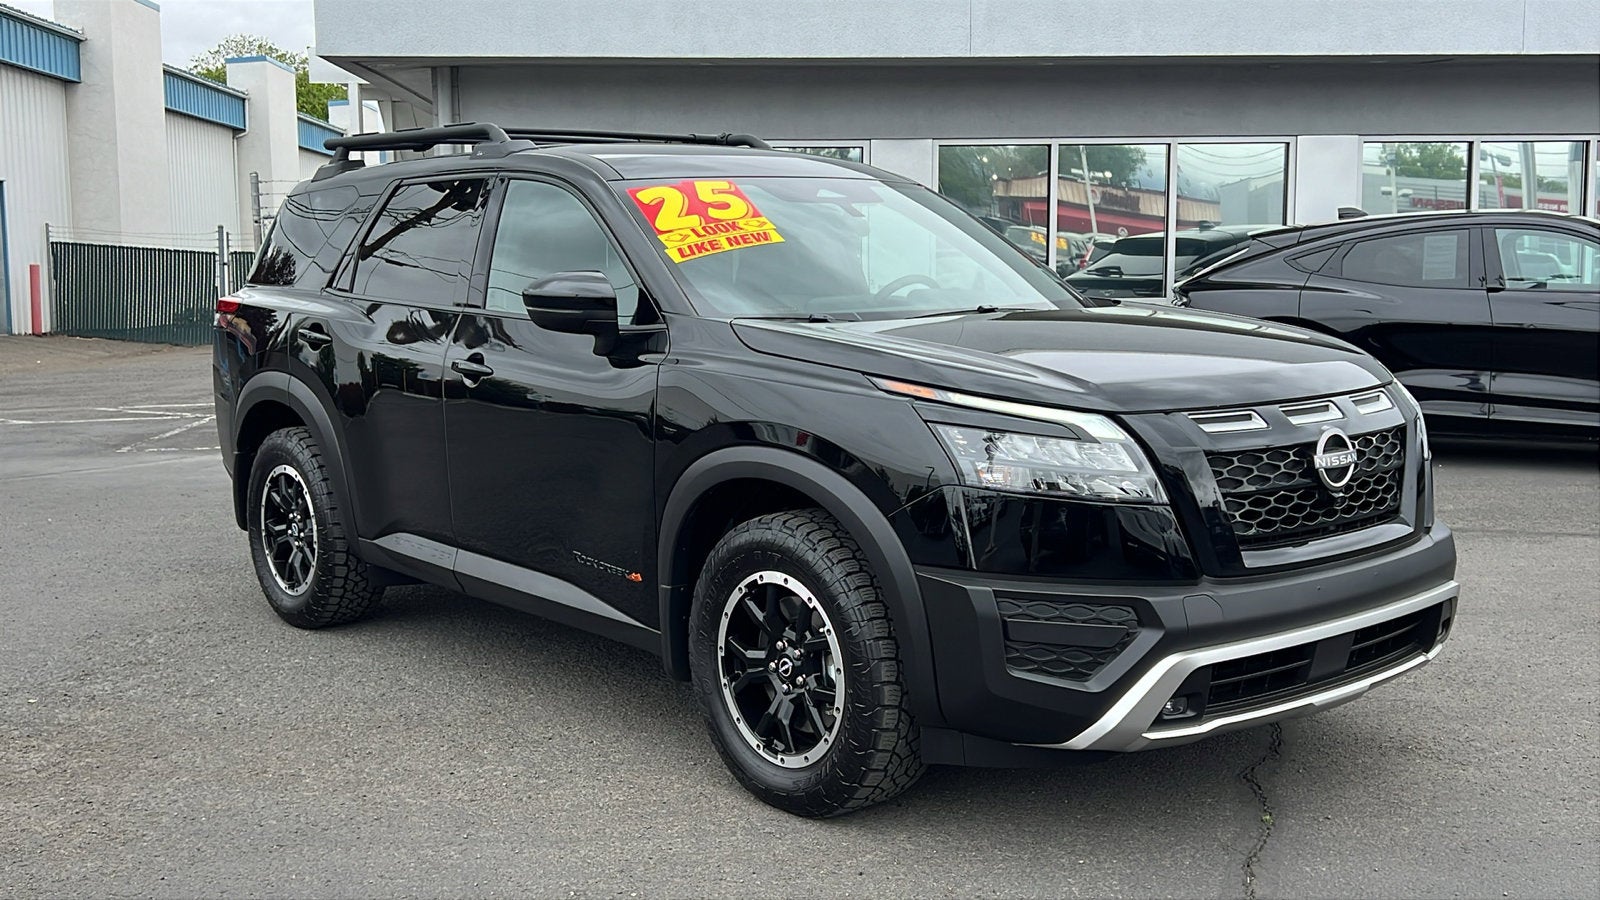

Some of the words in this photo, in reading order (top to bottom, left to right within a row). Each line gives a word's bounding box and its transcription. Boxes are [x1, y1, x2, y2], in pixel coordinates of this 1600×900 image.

[635, 180, 753, 231] 25
[690, 220, 744, 239] LOOK
[677, 239, 723, 259] LIKE
[728, 231, 771, 248] NEW
[1315, 453, 1358, 468] NISSAN
